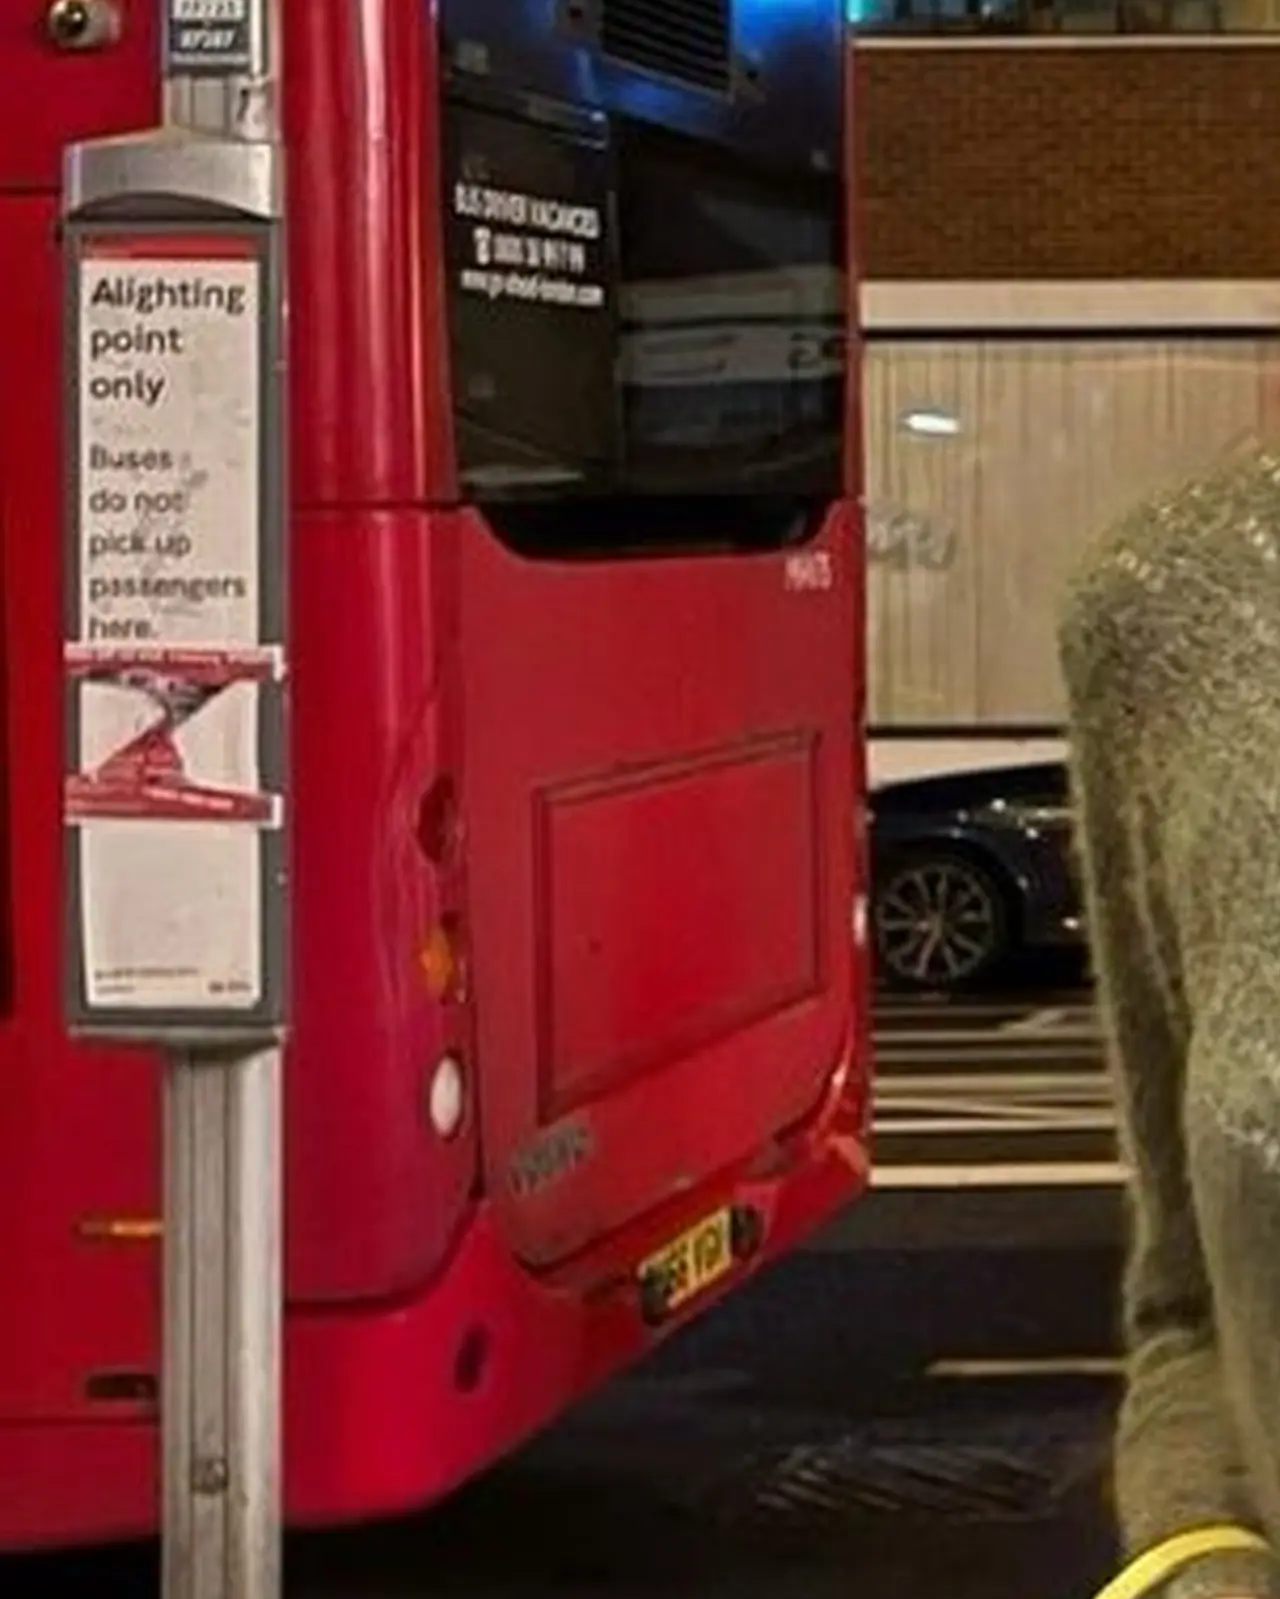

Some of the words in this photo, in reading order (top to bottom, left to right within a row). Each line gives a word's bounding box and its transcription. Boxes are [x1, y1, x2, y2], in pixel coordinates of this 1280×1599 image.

[91, 277, 246, 315] Alighting
[91, 322, 183, 362] point
[89, 369, 165, 407] only
[89, 443, 174, 471] Buses
[88, 489, 127, 514] do
[133, 490, 185, 515] not
[88, 531, 145, 559] pick
[154, 534, 192, 559] up
[88, 573, 247, 603] passengers
